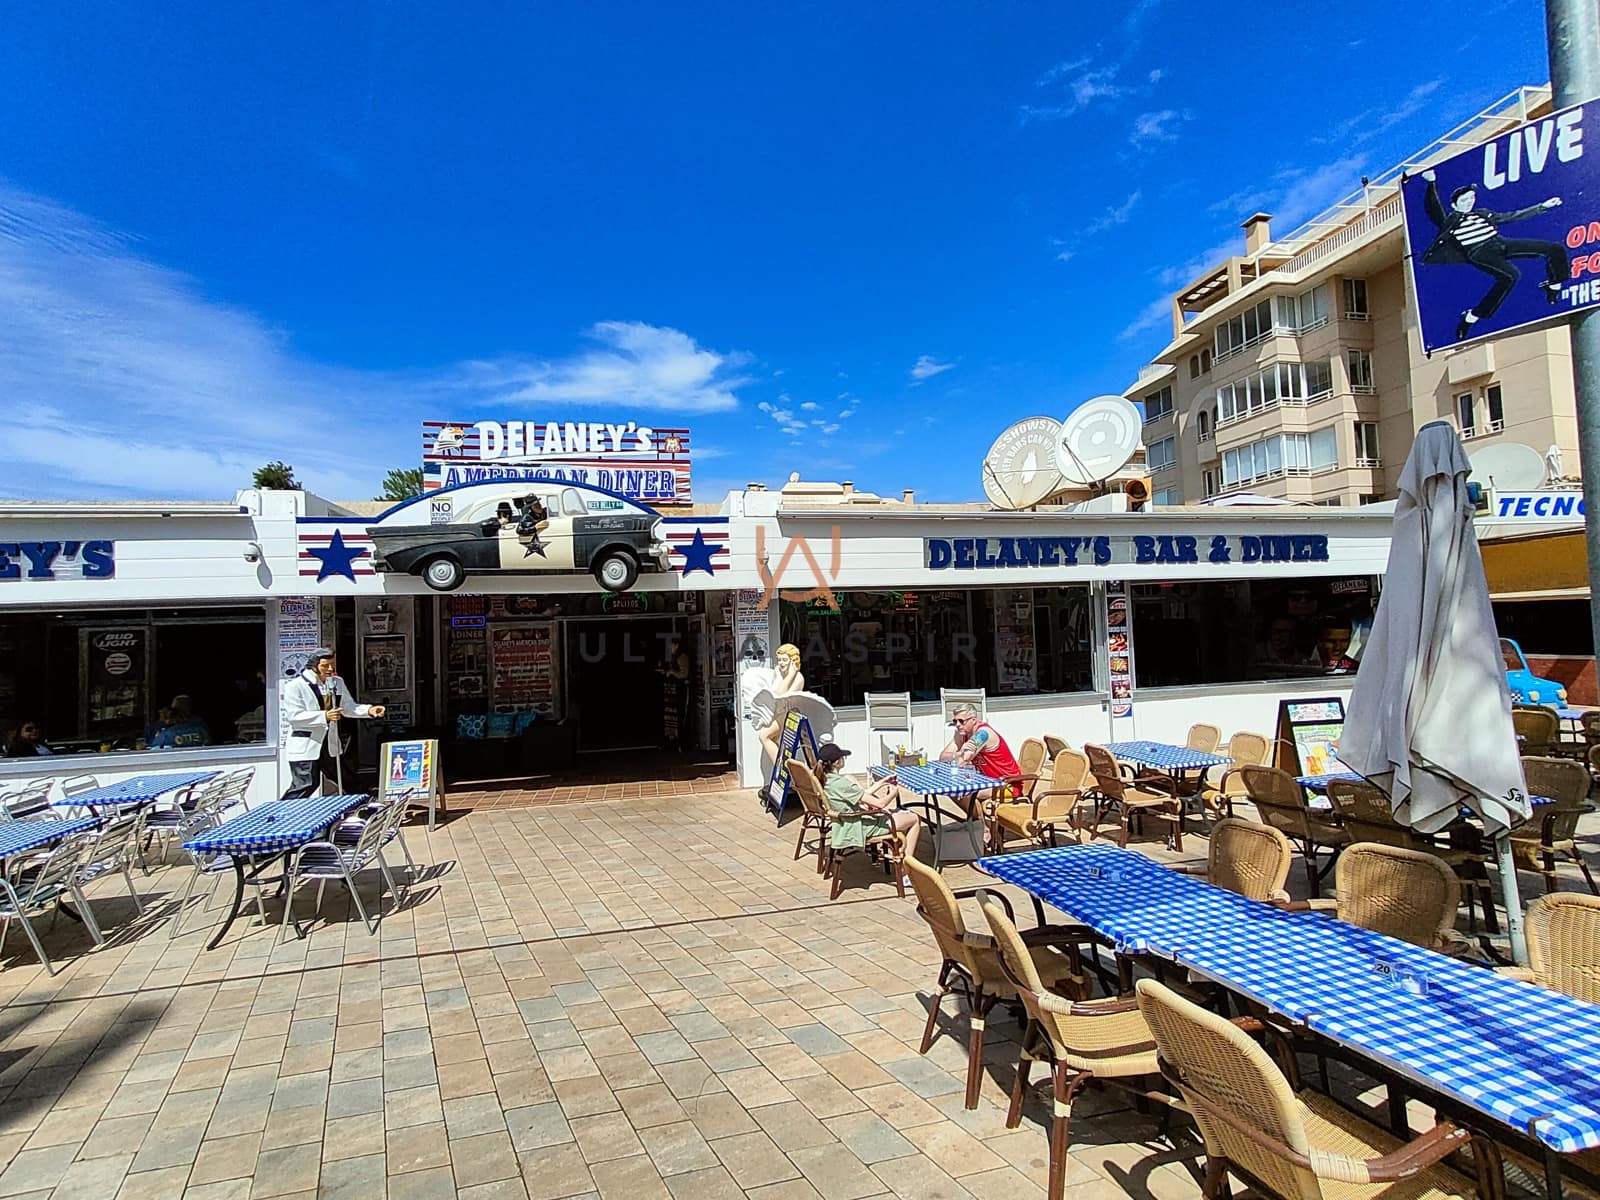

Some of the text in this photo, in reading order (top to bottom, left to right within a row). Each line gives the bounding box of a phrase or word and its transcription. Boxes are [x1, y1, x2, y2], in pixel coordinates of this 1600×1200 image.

[1482, 107, 1584, 190] LIVE
[473, 421, 653, 460] DELANEY'S
[597, 469, 676, 497] DINER
[432, 502, 451, 512] NO
[928, 533, 1330, 569] DELANEY'S BAR & DINER
[99, 639, 138, 647] LIGHT
[105, 632, 134, 641] BUD
[1376, 963, 1391, 974] 20
